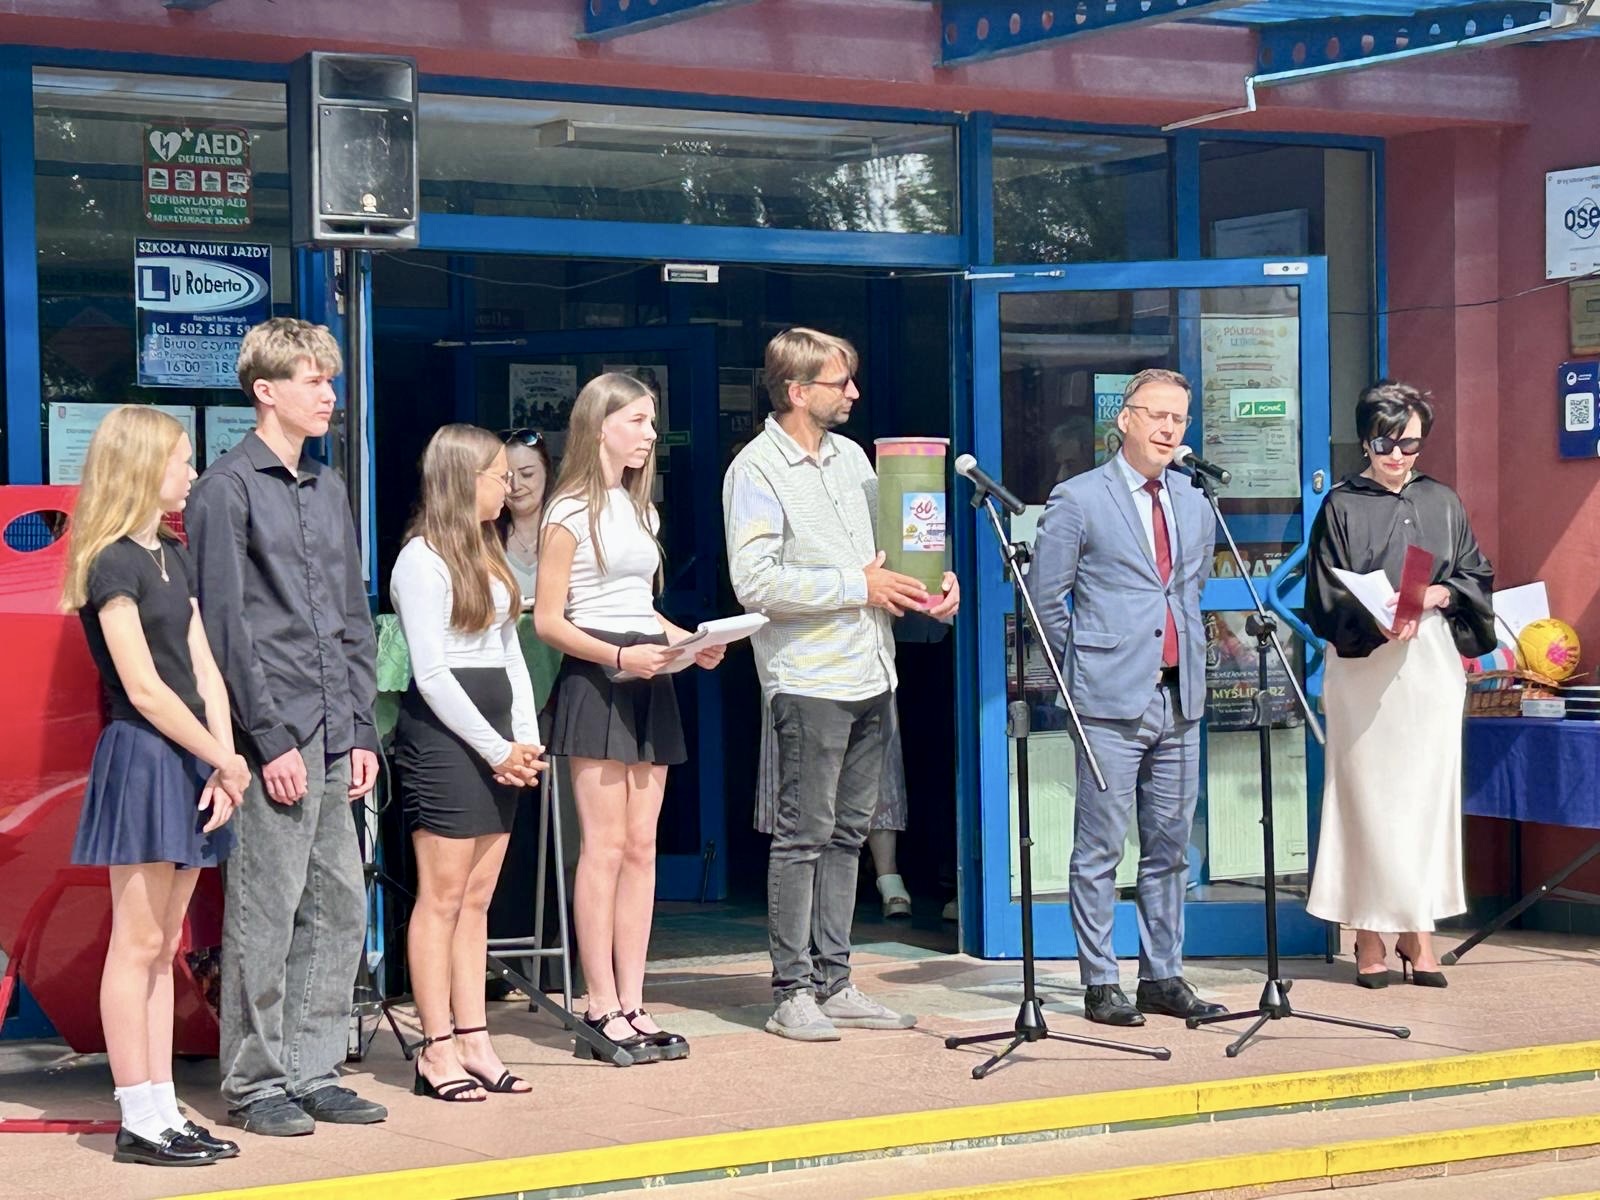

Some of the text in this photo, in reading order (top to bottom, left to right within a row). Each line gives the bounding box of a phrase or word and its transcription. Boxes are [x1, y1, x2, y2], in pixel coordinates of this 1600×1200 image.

[195, 133, 243, 156] AED
[178, 154, 243, 166] DEFIBRYLATOR
[150, 194, 247, 208] DEFIBRYLATOR AED
[139, 241, 269, 258] SZKOŁA NAUKI JAZDY
[179, 323, 202, 335] 502
[163, 336, 243, 351] Biuro czynn
